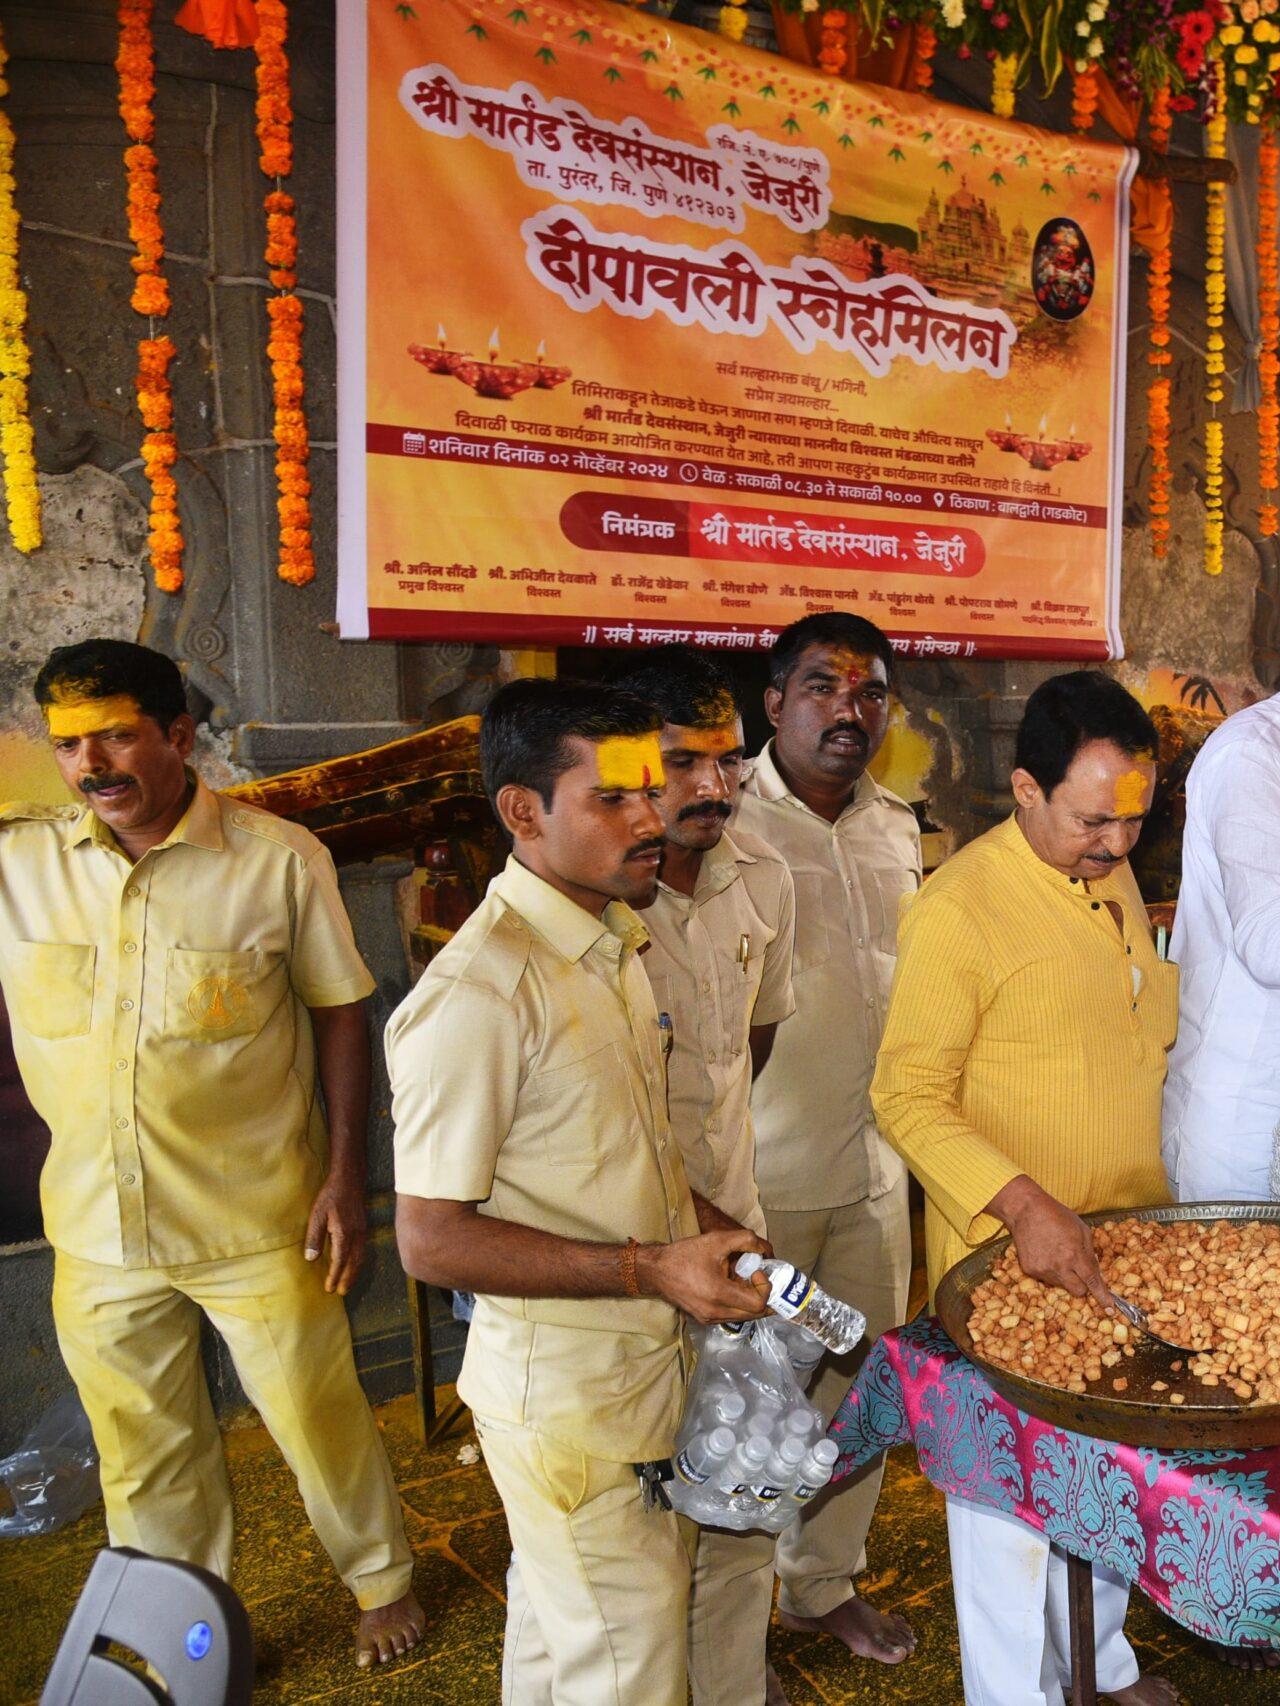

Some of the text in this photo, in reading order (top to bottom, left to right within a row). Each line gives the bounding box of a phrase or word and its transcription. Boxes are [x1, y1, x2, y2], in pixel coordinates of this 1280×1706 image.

[412, 75, 461, 126] श्री
[462, 93, 568, 151] मार्तंड
[741, 160, 823, 223] जेजुरी
[526, 160, 737, 224] ता. पुरंदर, जि. पुणे ४१२३०३
[534, 218, 1008, 368] दीपावली स्नेहमिलन
[716, 361, 738, 376] सर्व
[744, 385, 775, 402] सप्रेम
[571, 379, 647, 408] तिमिराकडून
[650, 390, 696, 412] तेजाकडे
[698, 398, 728, 417] घेऊन
[731, 406, 771, 423] जाणारा
[774, 412, 797, 427] सण
[799, 416, 833, 432] म्हणजे
[583, 404, 602, 421] श्री
[713, 421, 746, 443] जेजुरी
[803, 436, 848, 454] माननीय
[454, 409, 508, 433] दिवाळी
[510, 420, 552, 438] फराळ
[554, 424, 608, 446] कार्यक्रम
[612, 431, 671, 451] आयोजित
[673, 439, 724, 458] करण्यात
[727, 444, 745, 461] येत
[776, 452, 795, 467] तरी
[798, 456, 833, 472] आपण
[428, 436, 490, 459] शनिवार
[493, 441, 547, 464] दिनांक
[549, 452, 570, 467] ०२
[572, 451, 626, 473] नोव्हेंबर
[628, 460, 669, 478] २०२४
[701, 464, 727, 485] वेळ
[735, 473, 783, 490] सकाळी
[785, 479, 823, 497] ०८.३०
[825, 479, 836, 497] ते
[838, 485, 883, 501] सकाळी
[884, 490, 922, 504] १०.००
[949, 494, 991, 511] ठिकाण
[601, 510, 676, 540] निमंत्रक
[700, 512, 732, 545] श्री
[912, 530, 968, 573] जेजुरी
[383, 560, 404, 574] श्री.
[407, 562, 444, 576] अनिल
[398, 580, 425, 594] प्रमुख
[602, 622, 634, 643] सर्व
